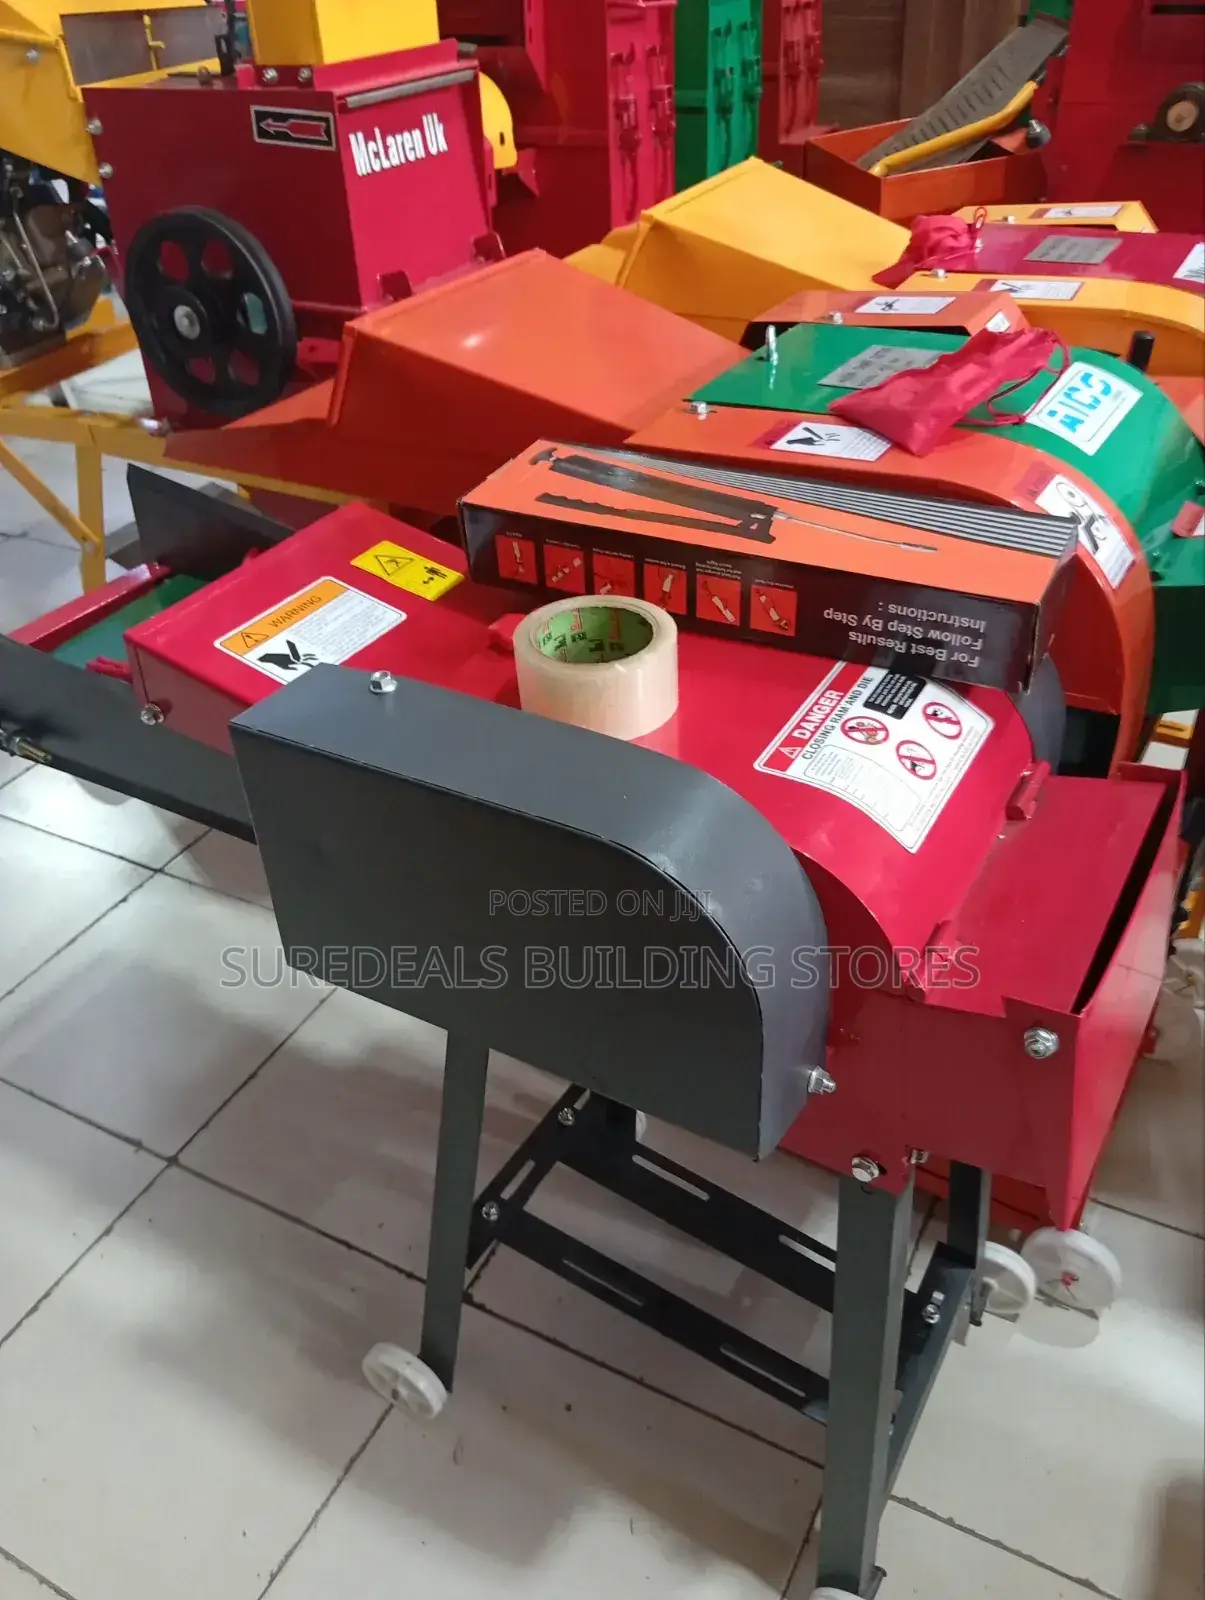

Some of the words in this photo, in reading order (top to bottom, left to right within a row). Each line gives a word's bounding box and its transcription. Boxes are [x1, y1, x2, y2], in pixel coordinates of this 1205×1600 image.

[348, 126, 426, 177] McLaren
[421, 112, 448, 156] Uk
[268, 595, 322, 628] WARNING
[823, 608, 858, 626] Step
[887, 604, 987, 632] Instructions
[861, 615, 884, 631] By
[887, 621, 924, 639] Step
[848, 631, 906, 653] Results
[927, 629, 984, 650] Follow
[909, 643, 947, 661] Best
[950, 652, 981, 668] For
[792, 690, 845, 739] DANGER
[802, 725, 837, 760] CLOSING
[833, 705, 850, 724] RAM
[848, 689, 863, 706] AND
[858, 676, 874, 689] DIE
